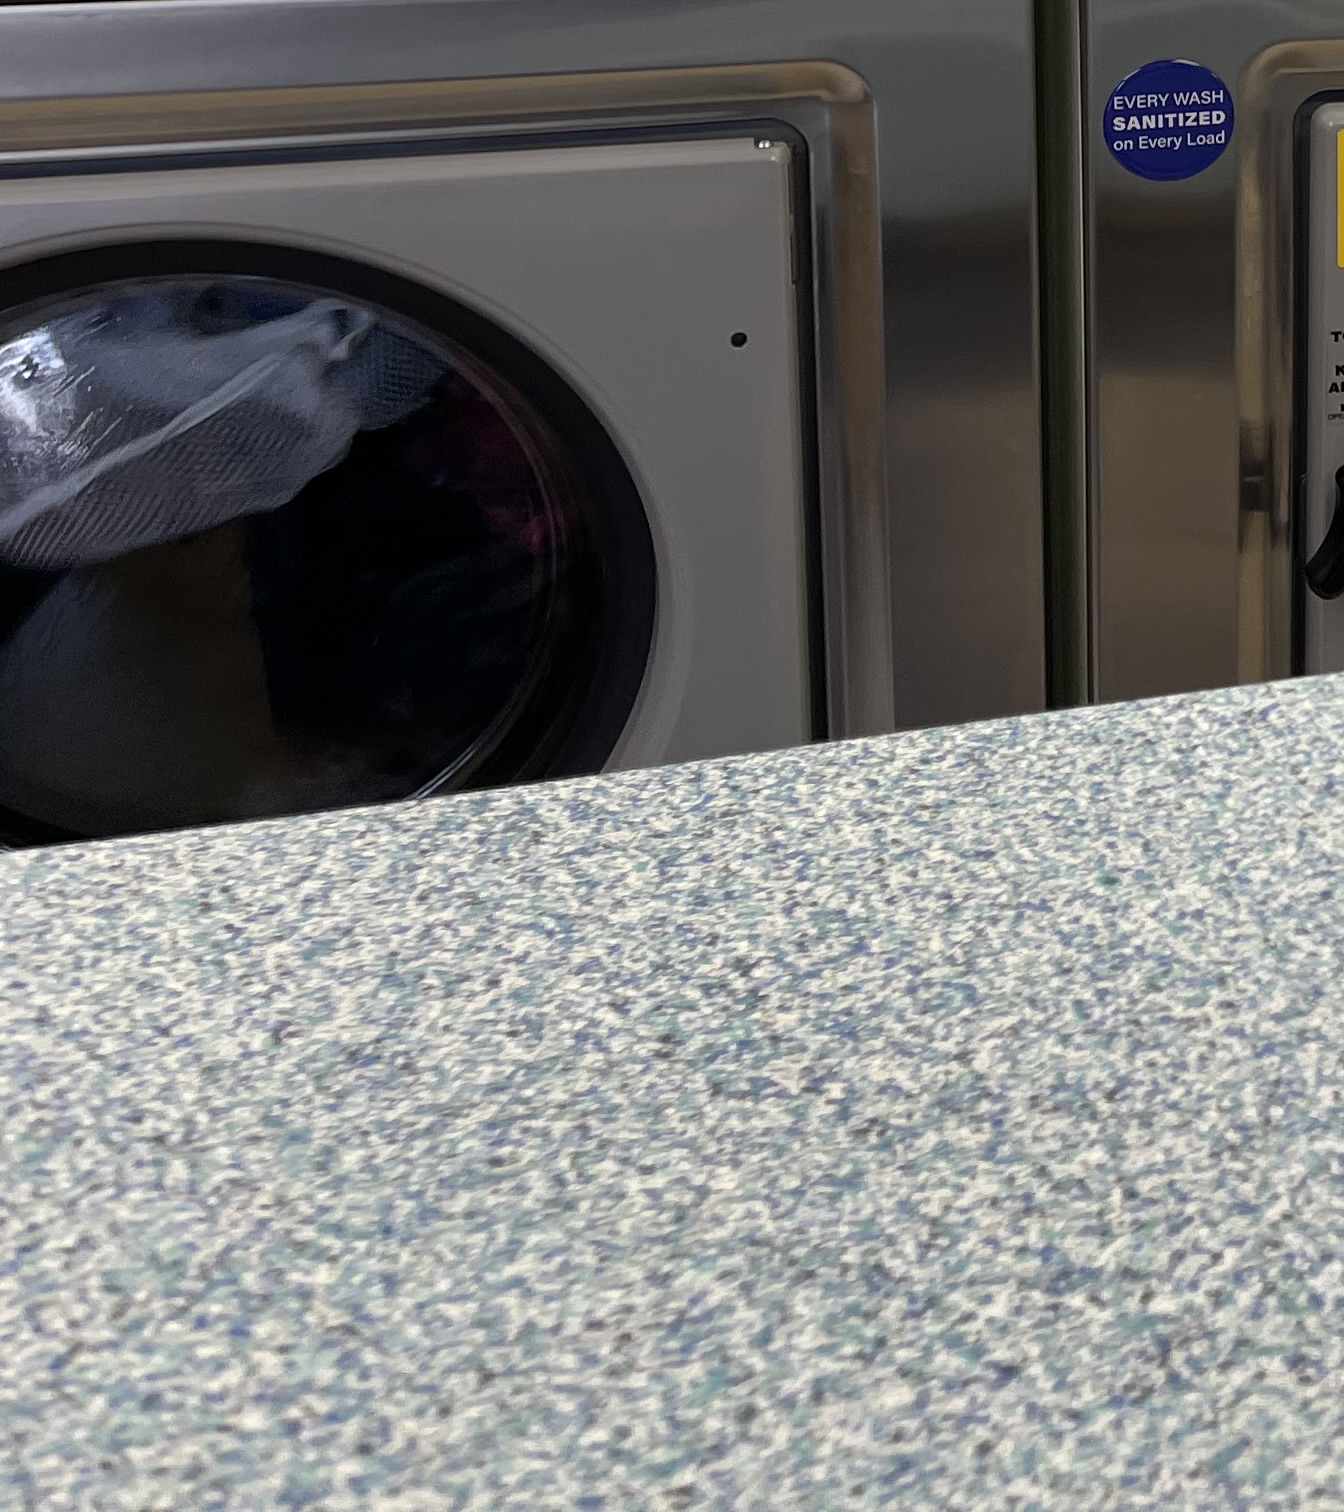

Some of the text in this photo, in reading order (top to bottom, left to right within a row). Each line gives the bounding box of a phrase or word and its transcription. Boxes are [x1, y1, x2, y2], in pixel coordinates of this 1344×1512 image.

[1113, 90, 1224, 110] EVERY WASH
[1113, 110, 1226, 131] SANITIZED
[1113, 130, 1225, 151] on Every Load
